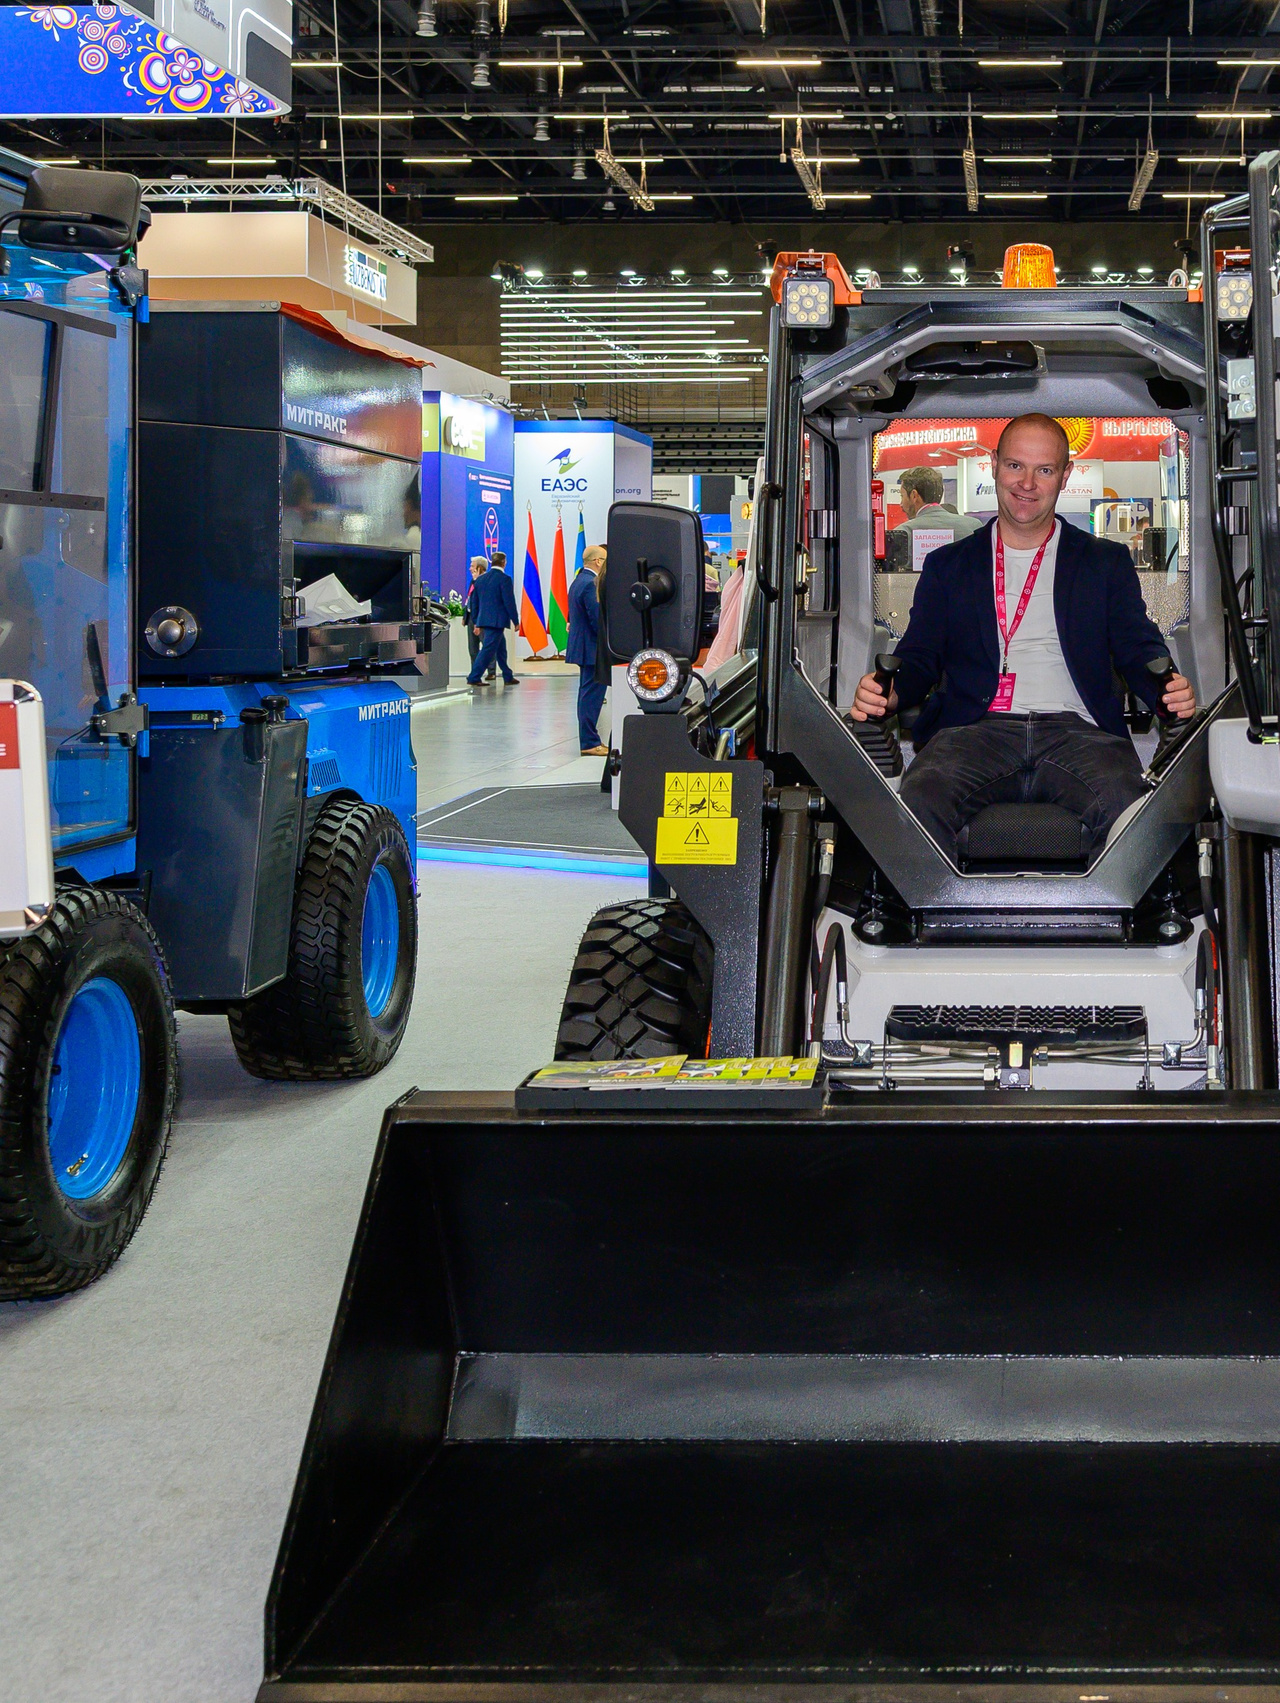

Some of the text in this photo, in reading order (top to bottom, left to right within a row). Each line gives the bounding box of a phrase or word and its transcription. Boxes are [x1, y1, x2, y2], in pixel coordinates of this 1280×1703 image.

[286, 403, 347, 435] МИТРАКС
[541, 478, 588, 492] ЕАЭС
[358, 699, 409, 722] МИТРАКС
